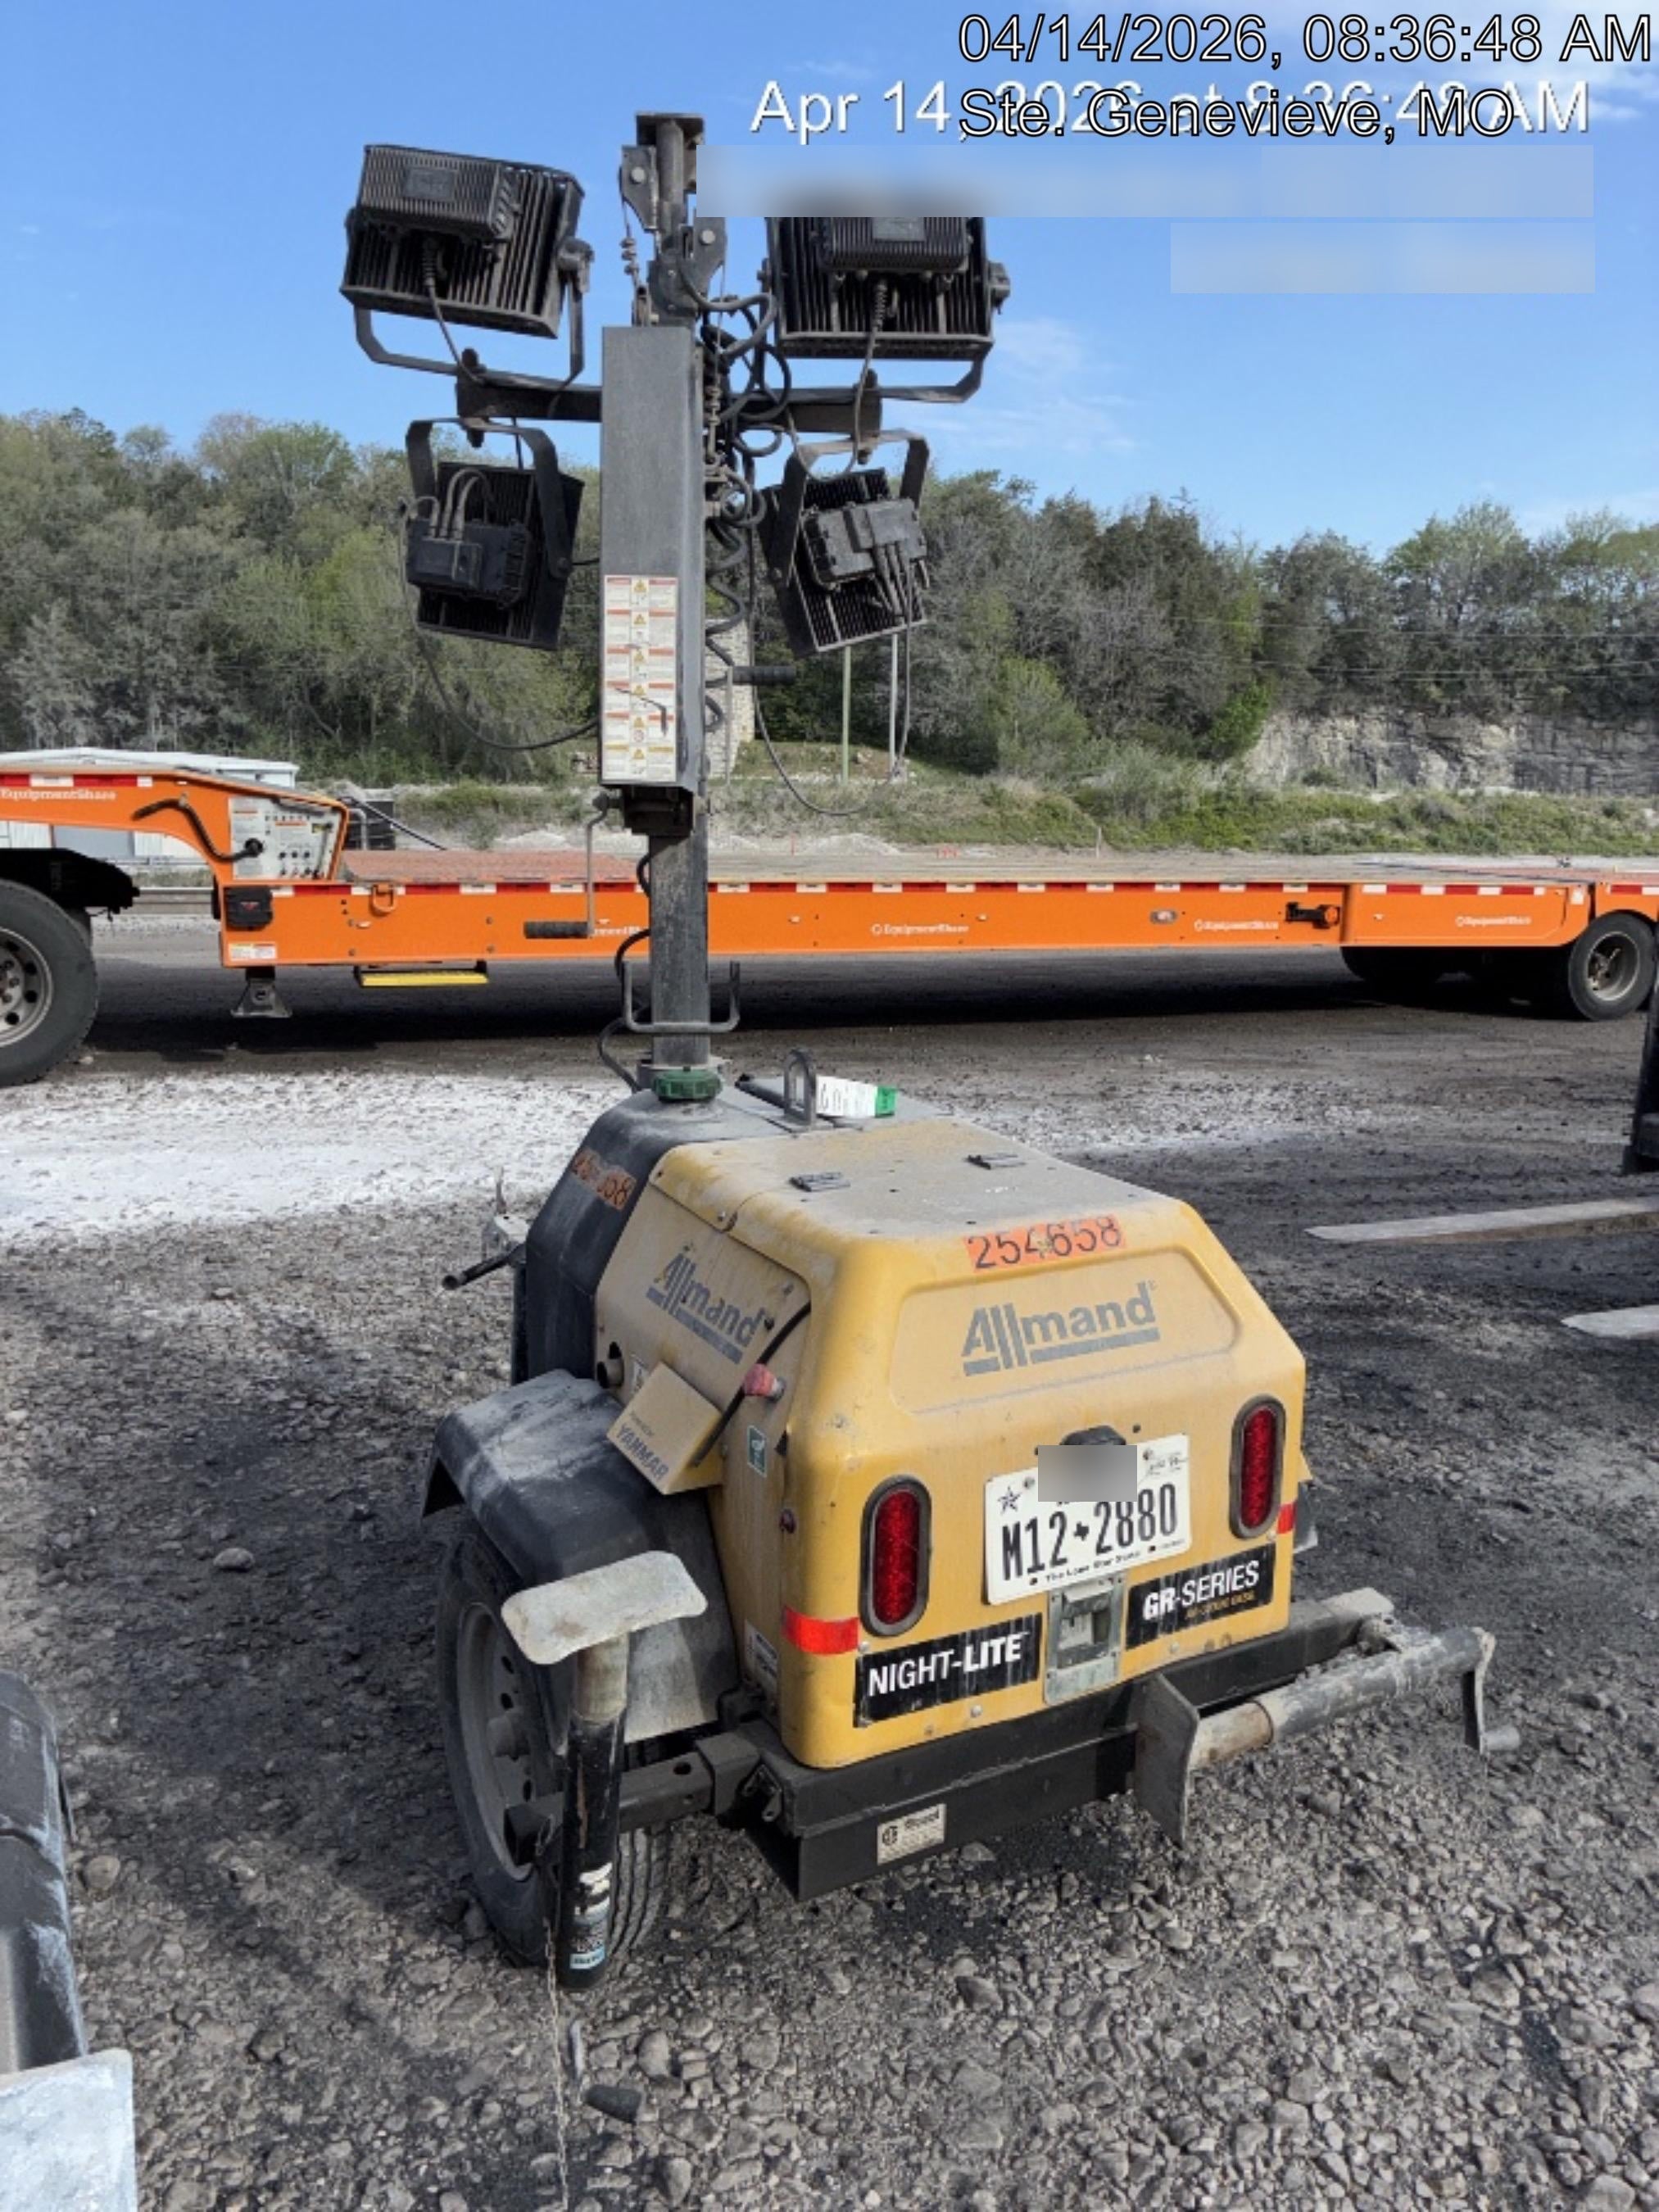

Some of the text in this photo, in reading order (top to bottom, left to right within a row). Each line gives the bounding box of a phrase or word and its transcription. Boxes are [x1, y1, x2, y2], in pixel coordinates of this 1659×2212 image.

[967, 1215, 1122, 1269] 254658
[664, 1253, 768, 1348] Allmand
[961, 1281, 1156, 1369] Allmand
[616, 1424, 669, 1480] YANMAR
[1001, 1511, 1068, 1581] M12
[1142, 1559, 1259, 1620] GR-SERIES
[868, 1633, 1022, 1697] NIGHT-LITE
